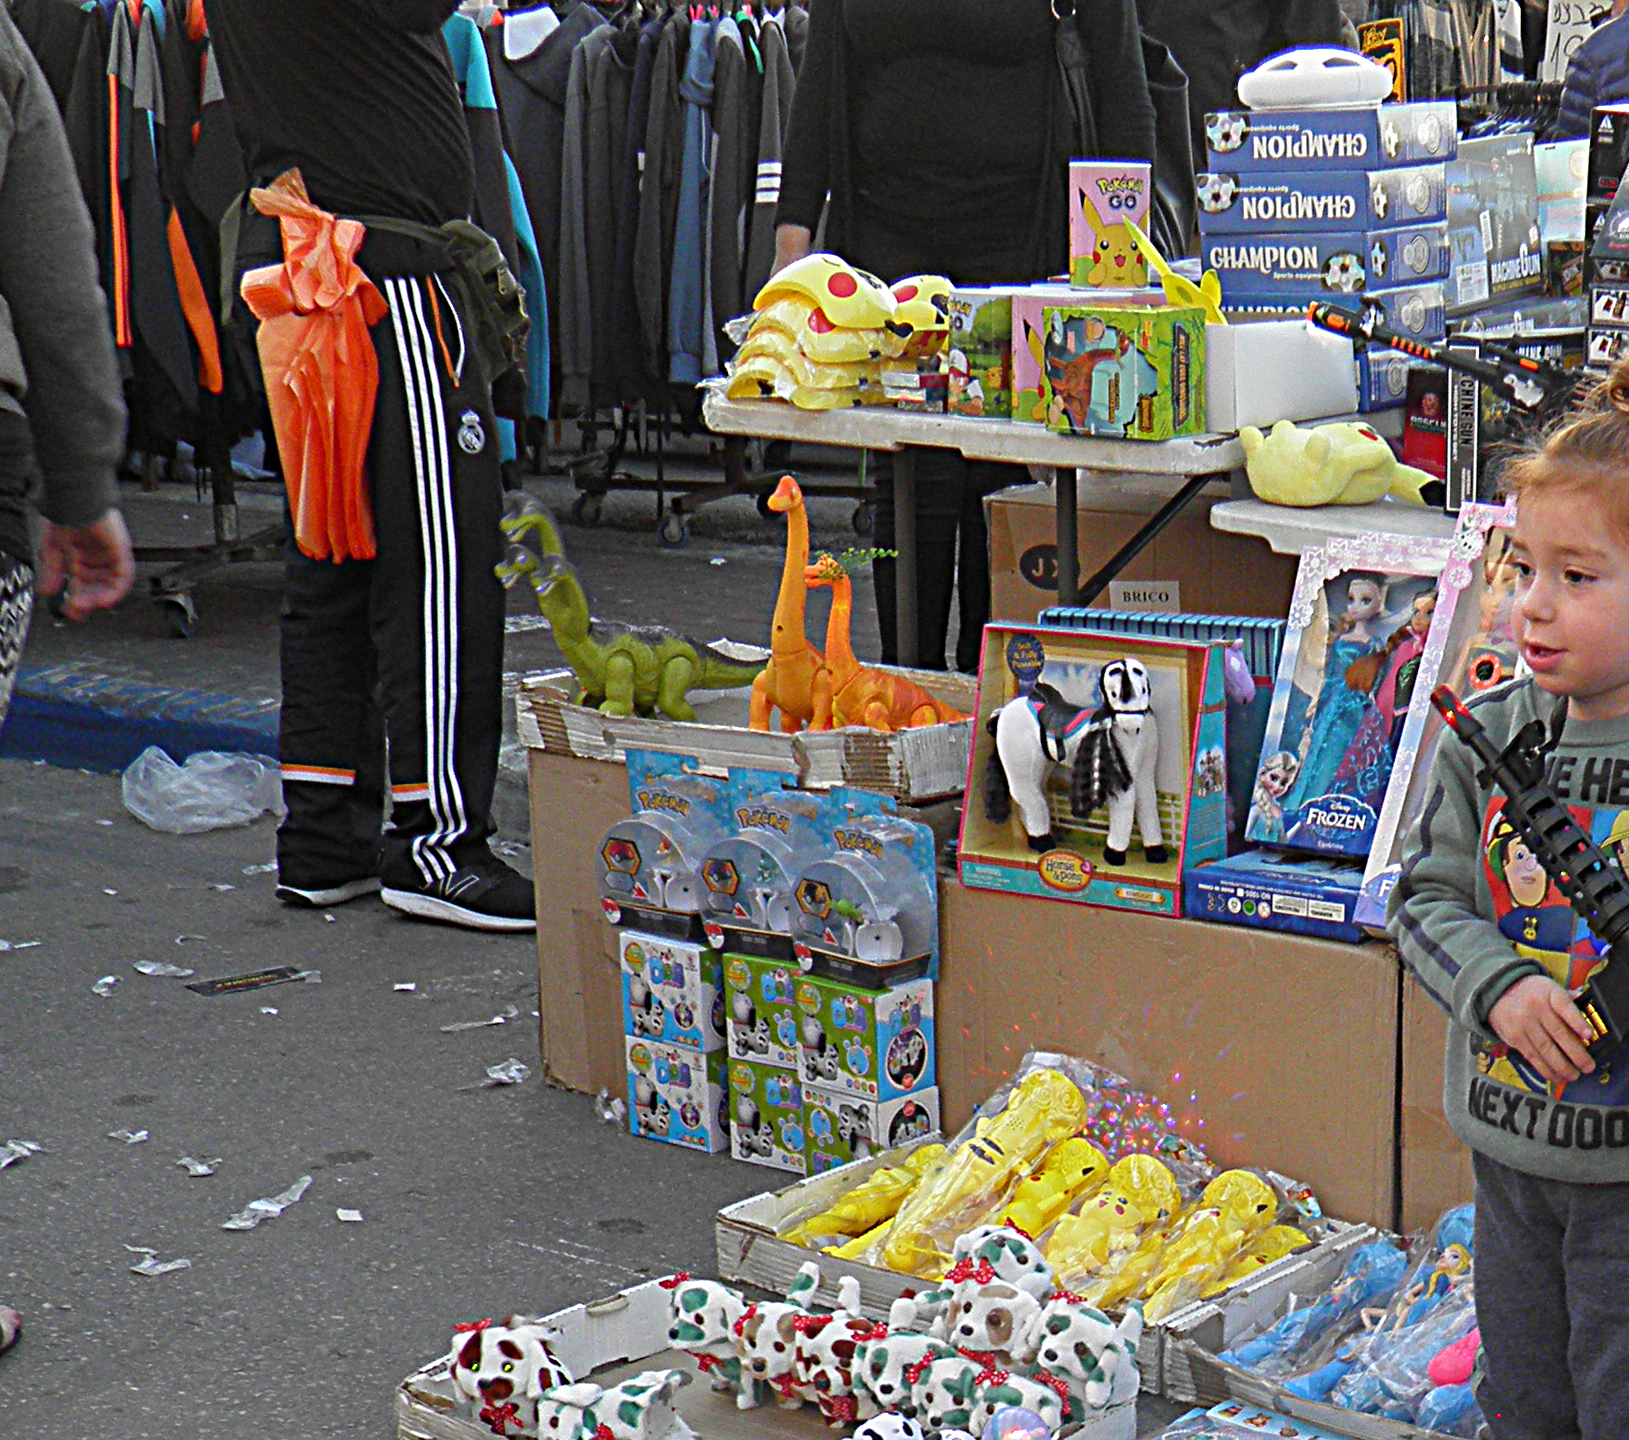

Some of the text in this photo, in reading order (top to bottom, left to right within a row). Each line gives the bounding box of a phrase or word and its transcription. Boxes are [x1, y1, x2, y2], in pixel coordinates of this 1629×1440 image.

[1253, 130, 1368, 159] CHAMPION
[1108, 195, 1138, 209] GO
[1243, 191, 1356, 219] CHAMPION
[1209, 246, 1319, 274] CHAMPION
[1122, 591, 1170, 604] BRICO
[1306, 808, 1367, 831] FROZEN
[1467, 1079, 1547, 1139] NEXT
